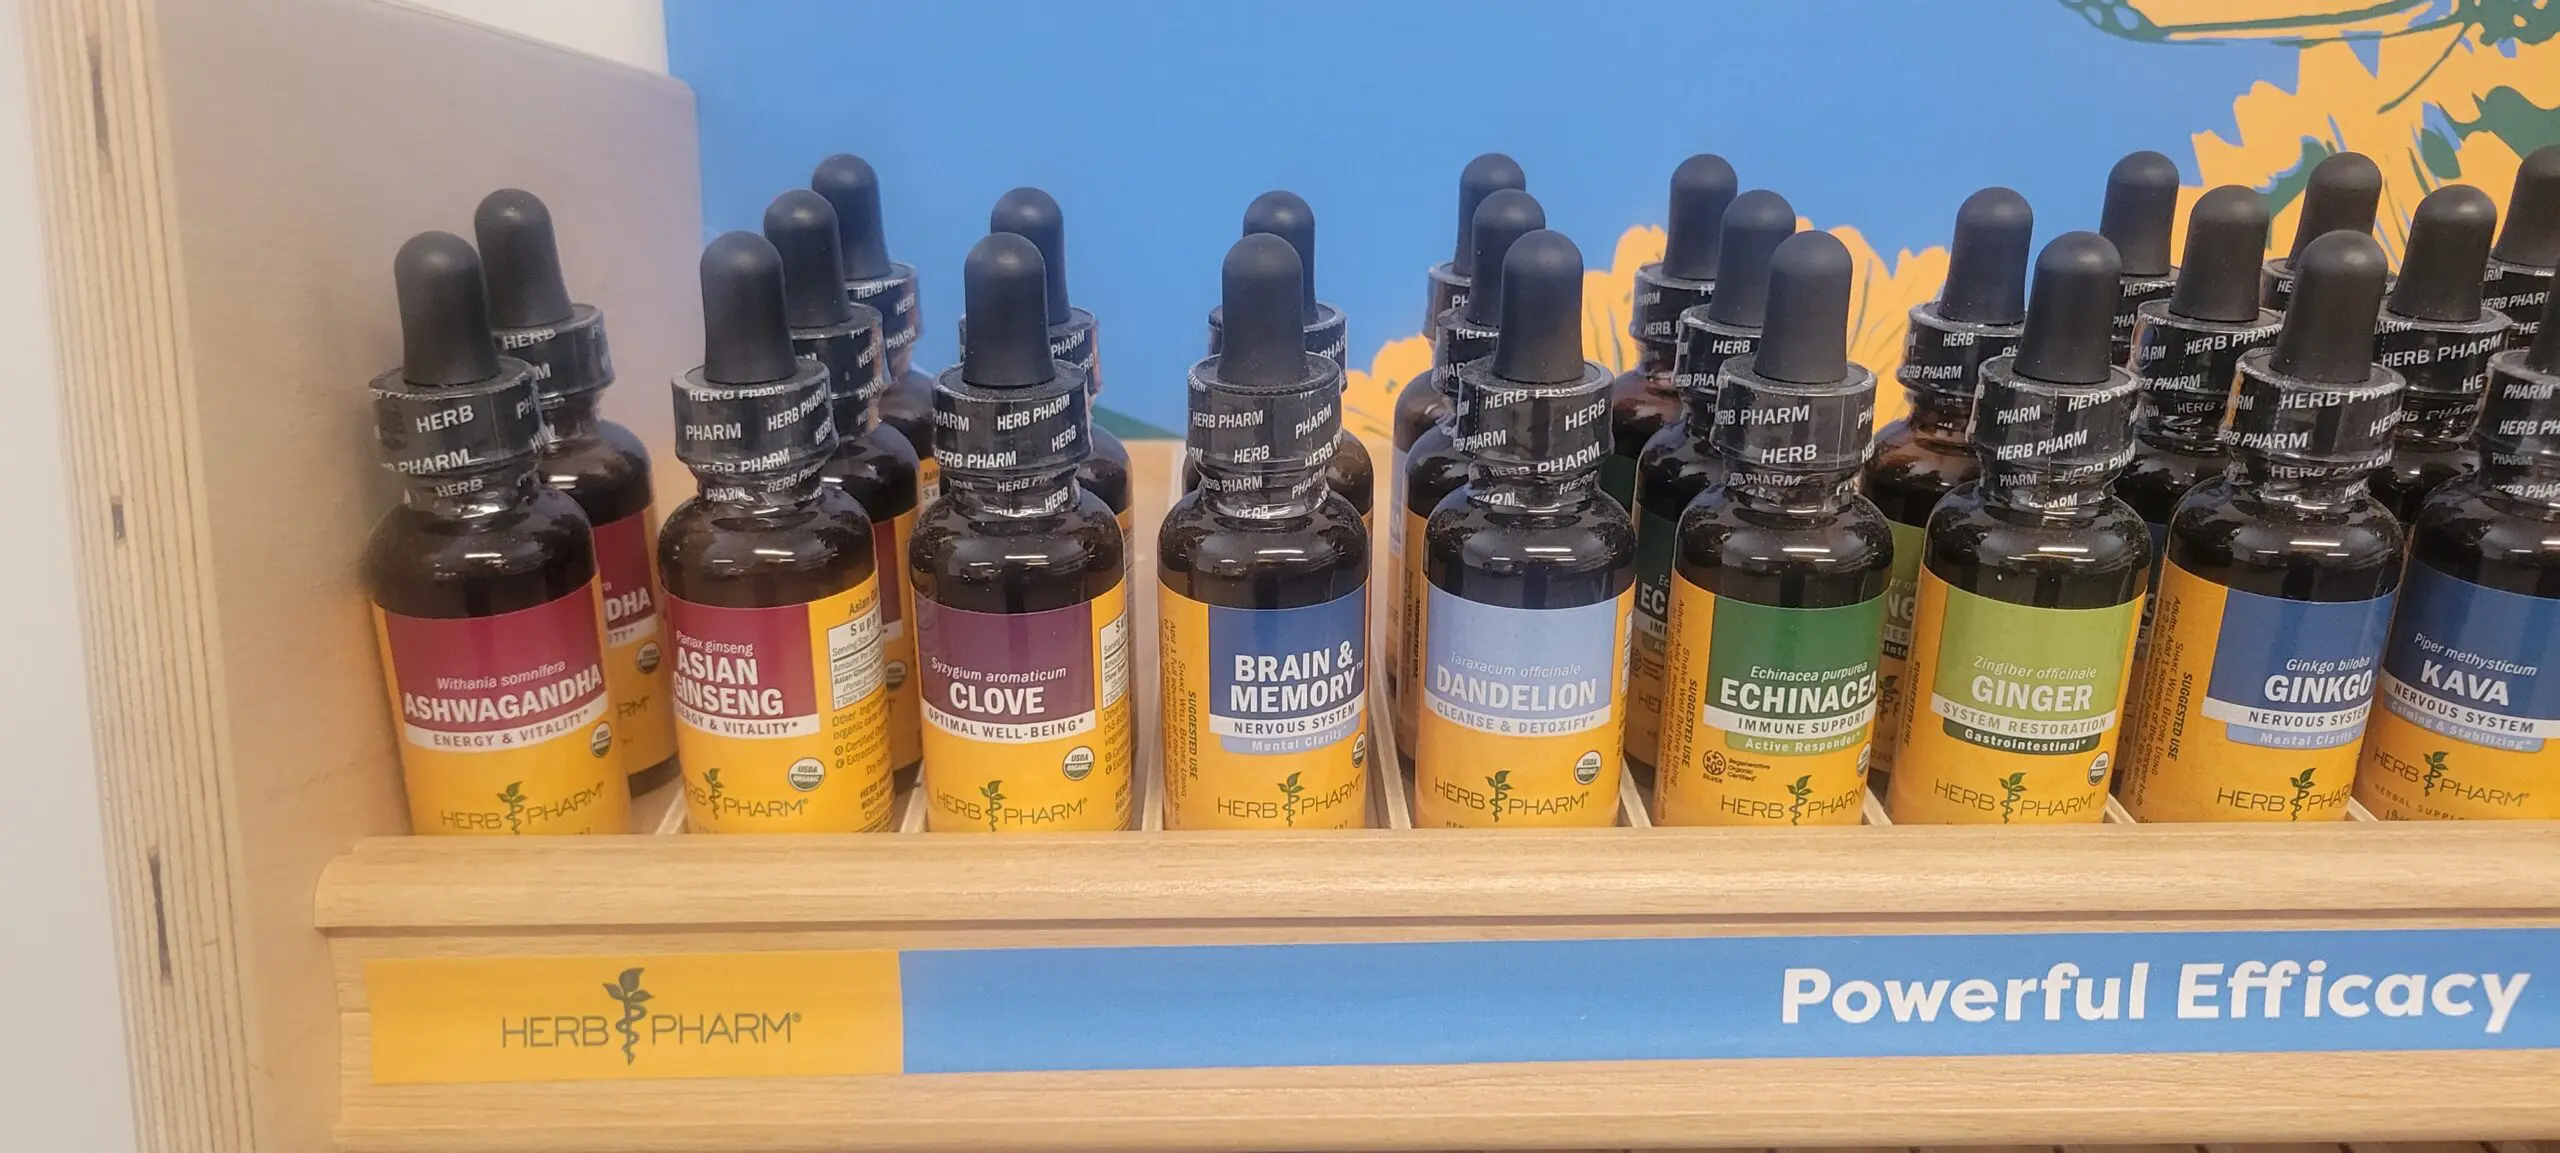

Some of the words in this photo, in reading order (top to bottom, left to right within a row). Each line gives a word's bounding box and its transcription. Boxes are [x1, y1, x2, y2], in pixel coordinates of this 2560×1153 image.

[896, 293, 915, 315] HERB
[886, 327, 917, 350] PHARM
[1712, 340, 1751, 355] HERB
[1943, 332, 1975, 347] HERB
[2185, 335, 2227, 355] HERB
[2382, 350, 2430, 368] HERB
[2437, 334, 2502, 362] PHARM
[1922, 365, 1962, 380] PHARM
[2154, 373, 2201, 390] PHARM
[1484, 390, 1527, 411] HERB
[2068, 391, 2112, 412] HERB
[2280, 391, 2341, 410] HERB
[2503, 383, 2553, 399] PHARM
[416, 404, 475, 434] HERB
[767, 406, 799, 433] HERB
[997, 409, 1031, 431] HERB
[1033, 394, 1070, 424] PHARM
[1192, 412, 1216, 428] HERB
[1218, 409, 1264, 428] PHARM
[1295, 403, 1333, 440] PHARM
[1565, 398, 1605, 432] HERB
[1740, 405, 1810, 426] PHARM
[1997, 404, 2041, 426] PHARM
[686, 422, 742, 441] PHARM
[1051, 425, 1077, 453] HERB
[1466, 430, 1507, 450] PHARM
[2241, 432, 2308, 449] PHARM
[2498, 420, 2537, 436] HERB
[1233, 445, 1271, 464] HERB
[1761, 444, 1818, 465] HERB
[1997, 445, 2034, 461] HERB
[2036, 429, 2088, 456] PHARM
[399, 448, 470, 476] PHARM
[933, 449, 963, 469] HERB
[967, 451, 1017, 469] PHARM
[1538, 444, 1600, 475] PHARM
[436, 477, 484, 499] HERB
[1999, 473, 2038, 488] PHARM
[1045, 485, 1069, 512] HERB
[676, 630, 703, 650] Panax
[706, 640, 754, 657] ginseng
[2414, 632, 2444, 655] Piper
[2446, 645, 2537, 677] methysticum
[678, 648, 759, 685] ASIAN
[932, 657, 982, 681] Syzygium
[987, 666, 1067, 683] aromaticum
[1235, 648, 1330, 683] BRAIN
[1337, 640, 1353, 669] &
[1451, 652, 1516, 677] Taraxacum
[1520, 663, 1581, 678] officinale
[1679, 647, 1690, 684] Shake
[1750, 665, 1819, 682] Echinacea
[1821, 661, 1868, 682] purpurea
[1973, 656, 2034, 677] Zingiber
[2036, 667, 2097, 680] officinale
[2286, 658, 2334, 674] Ginkgo
[2338, 656, 2371, 672] biloba
[436, 676, 497, 691] Withania
[501, 660, 566, 686] somnifera
[1436, 664, 1597, 712] DANDELION
[2264, 670, 2373, 704] GINKGO
[2421, 659, 2510, 706] KAVA
[405, 663, 603, 723] ASHWAGANDHA
[673, 675, 783, 716] GINSENG
[950, 681, 1046, 716] CLOVE
[1677, 689, 1687, 713] Well
[1720, 670, 1877, 714] ECHINACEA
[1972, 675, 2093, 712] GINGER
[2172, 671, 2194, 737] SUGGESTED
[1234, 720, 1305, 735] NERVOUS
[1312, 702, 1356, 730] SYSTEM
[1437, 702, 1494, 730] CLEANSE
[1500, 721, 1510, 733] &
[1684, 678, 1697, 743] SUGGESTED
[1943, 702, 2001, 730] SYSTEM
[2008, 717, 2107, 736] RESTORATION
[2249, 711, 2324, 728] NERVOUS
[2394, 682, 2459, 719] NERVOUS
[2465, 711, 2534, 734] SYSTEM
[709, 717, 718, 731] &
[928, 709, 977, 736] OPTIMAL
[1188, 691, 1198, 755] SUGGESTED
[1738, 717, 1805, 734] IMMUNE
[1811, 711, 1866, 734] SUPPORT
[434, 733, 494, 747] ENERGY
[502, 732, 513, 745] &
[1252, 738, 1299, 752] Mental
[1745, 738, 1789, 752] Active
[2167, 737, 2181, 762] USE
[2260, 733, 2311, 747] Mental
[1190, 757, 1198, 781] USE
[1682, 744, 1692, 768] USE
[2374, 746, 2420, 783] HERB
[937, 788, 982, 820] HERB
[1435, 776, 1485, 811] HERB
[1720, 794, 1784, 819] HERB
[1934, 778, 1995, 811] HERB
[2216, 786, 2285, 812] HERB
[2307, 783, 2350, 812] PHAR
[441, 809, 502, 830] HERB
[1218, 797, 1278, 819] HERB
[1779, 962, 2149, 1025] Powerful
[2178, 960, 2532, 1034] Efficacy
[501, 1014, 609, 1049] HERB
